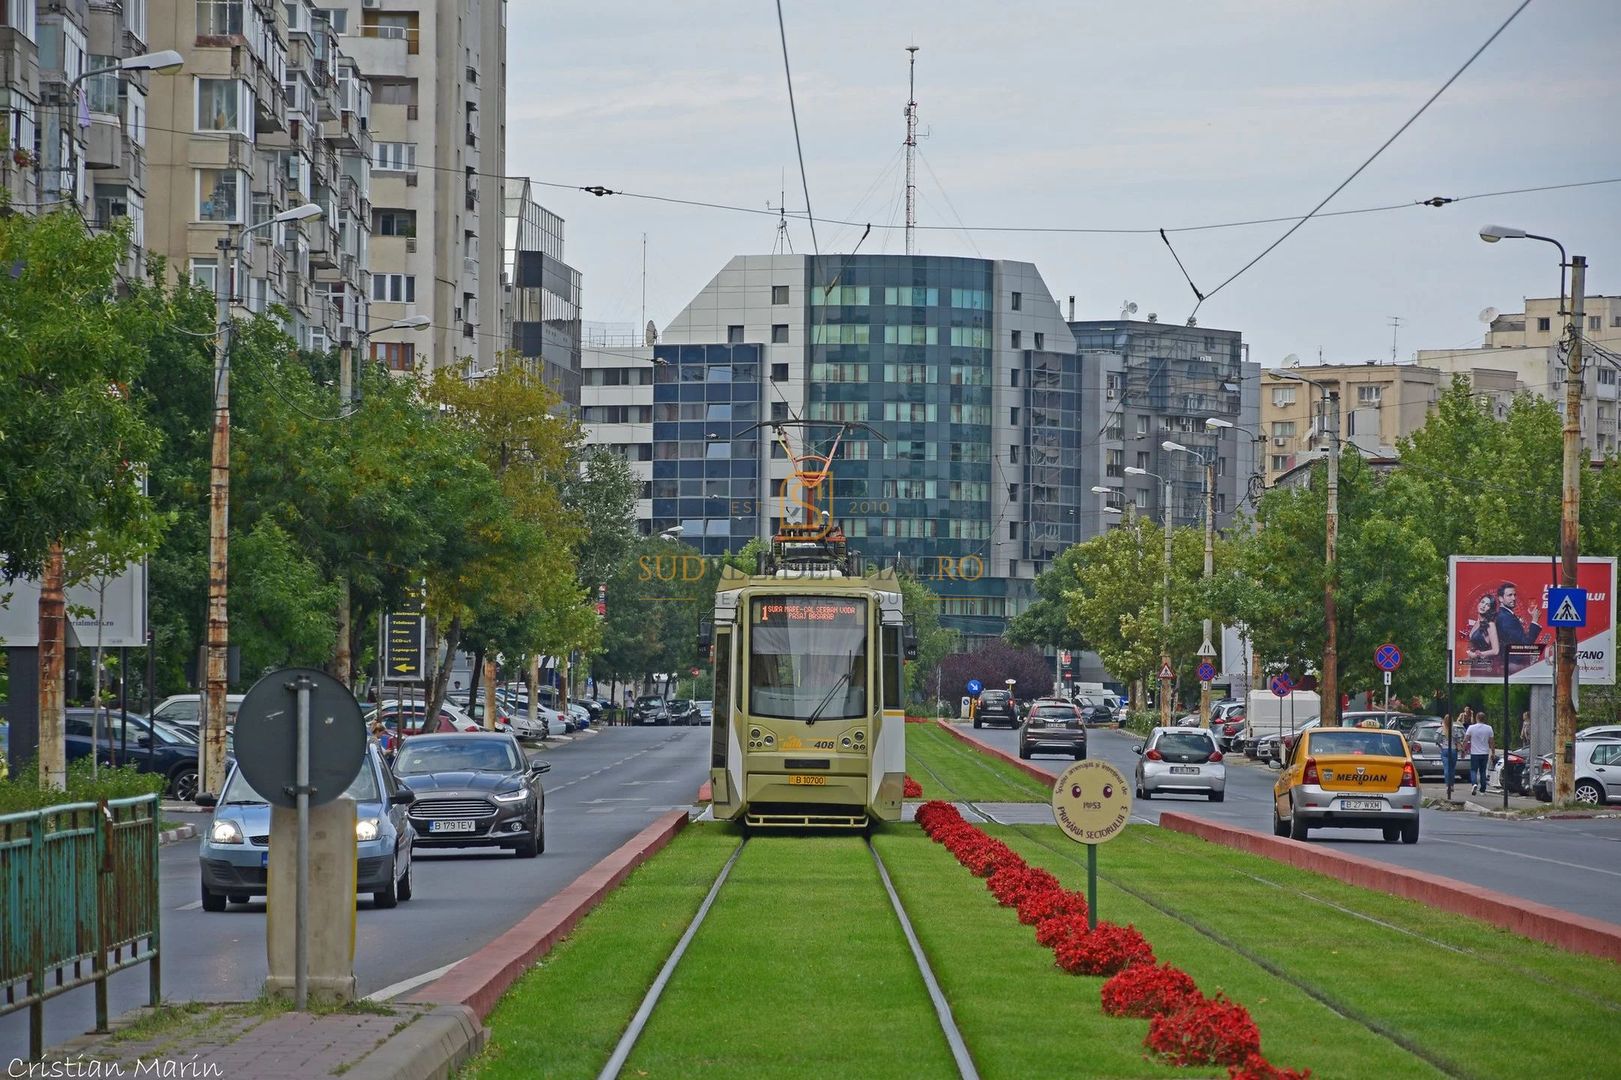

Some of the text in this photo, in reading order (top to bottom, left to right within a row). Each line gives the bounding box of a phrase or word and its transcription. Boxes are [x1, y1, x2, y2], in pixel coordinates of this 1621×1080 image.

[761, 605, 769, 621] 1
[840, 607, 856, 615] VODA
[1577, 650, 1604, 660] TANO
[814, 741, 835, 749] 408
[795, 776, 825, 785] B 10700
[1336, 773, 1388, 782] MERIDIAN
[434, 821, 473, 830] B 179 TEV
[1085, 814, 1125, 839] SECTORULUI
